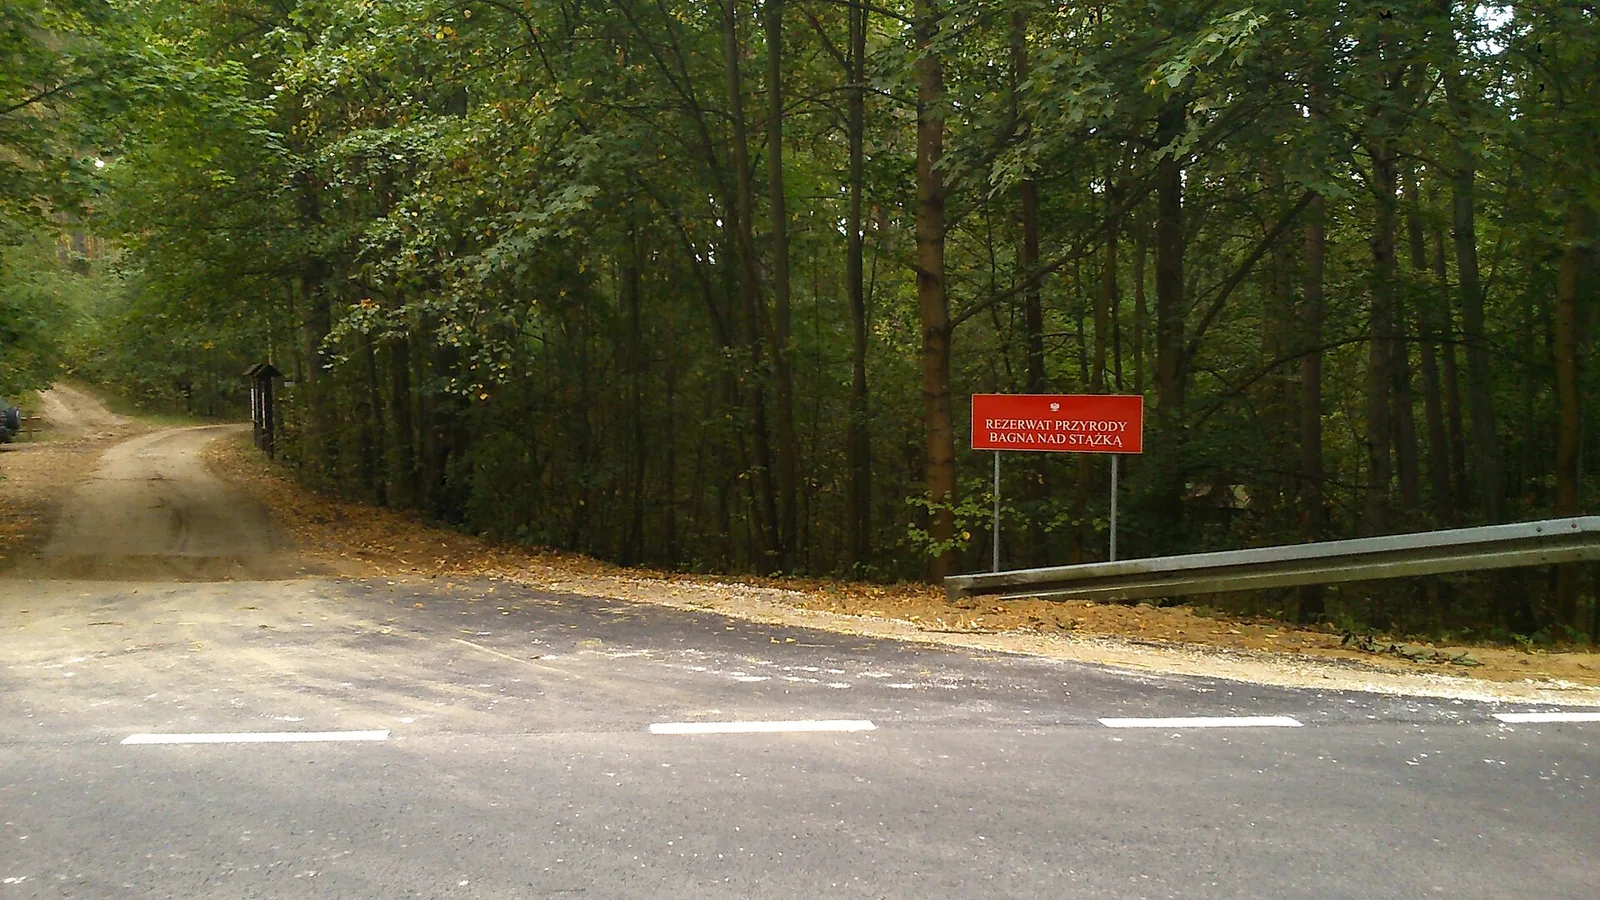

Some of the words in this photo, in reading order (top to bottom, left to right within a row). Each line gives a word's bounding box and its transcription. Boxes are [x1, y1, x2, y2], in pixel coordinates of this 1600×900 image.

[985, 419, 1052, 431] REZERWAT
[1055, 420, 1128, 432] PRZYRODY
[989, 432, 1035, 443] BAGNA
[1037, 433, 1066, 444] NAD
[1069, 432, 1123, 448] STĄŻKĄ
